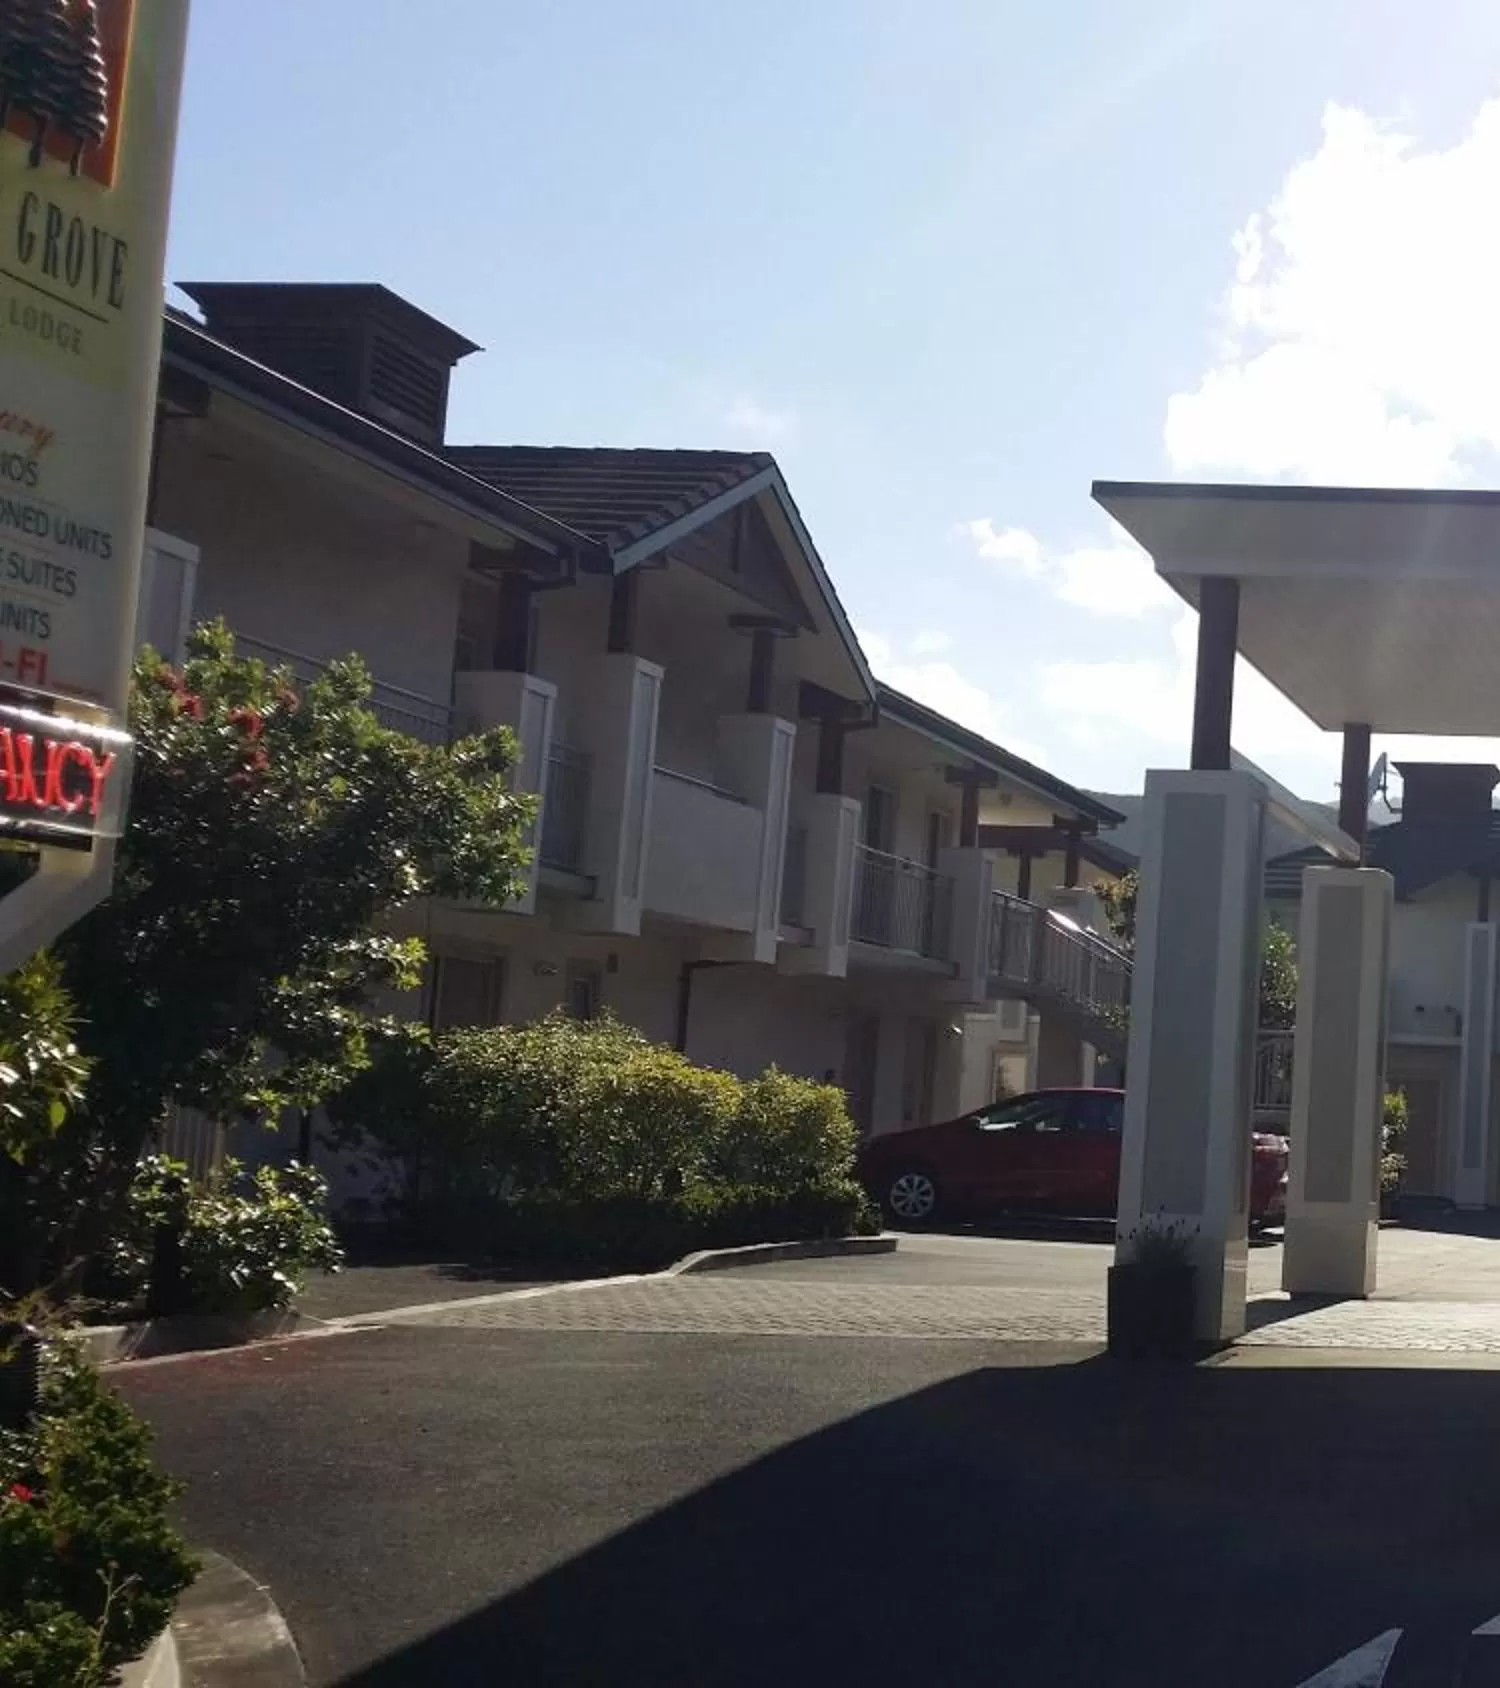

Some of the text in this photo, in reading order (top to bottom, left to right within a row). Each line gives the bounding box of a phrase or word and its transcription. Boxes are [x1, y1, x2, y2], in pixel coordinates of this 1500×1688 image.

[18, 191, 128, 311] GROVE
[10, 299, 82, 356] LODGE
[54, 524, 112, 560] UNITS
[7, 551, 76, 597] SUITES
